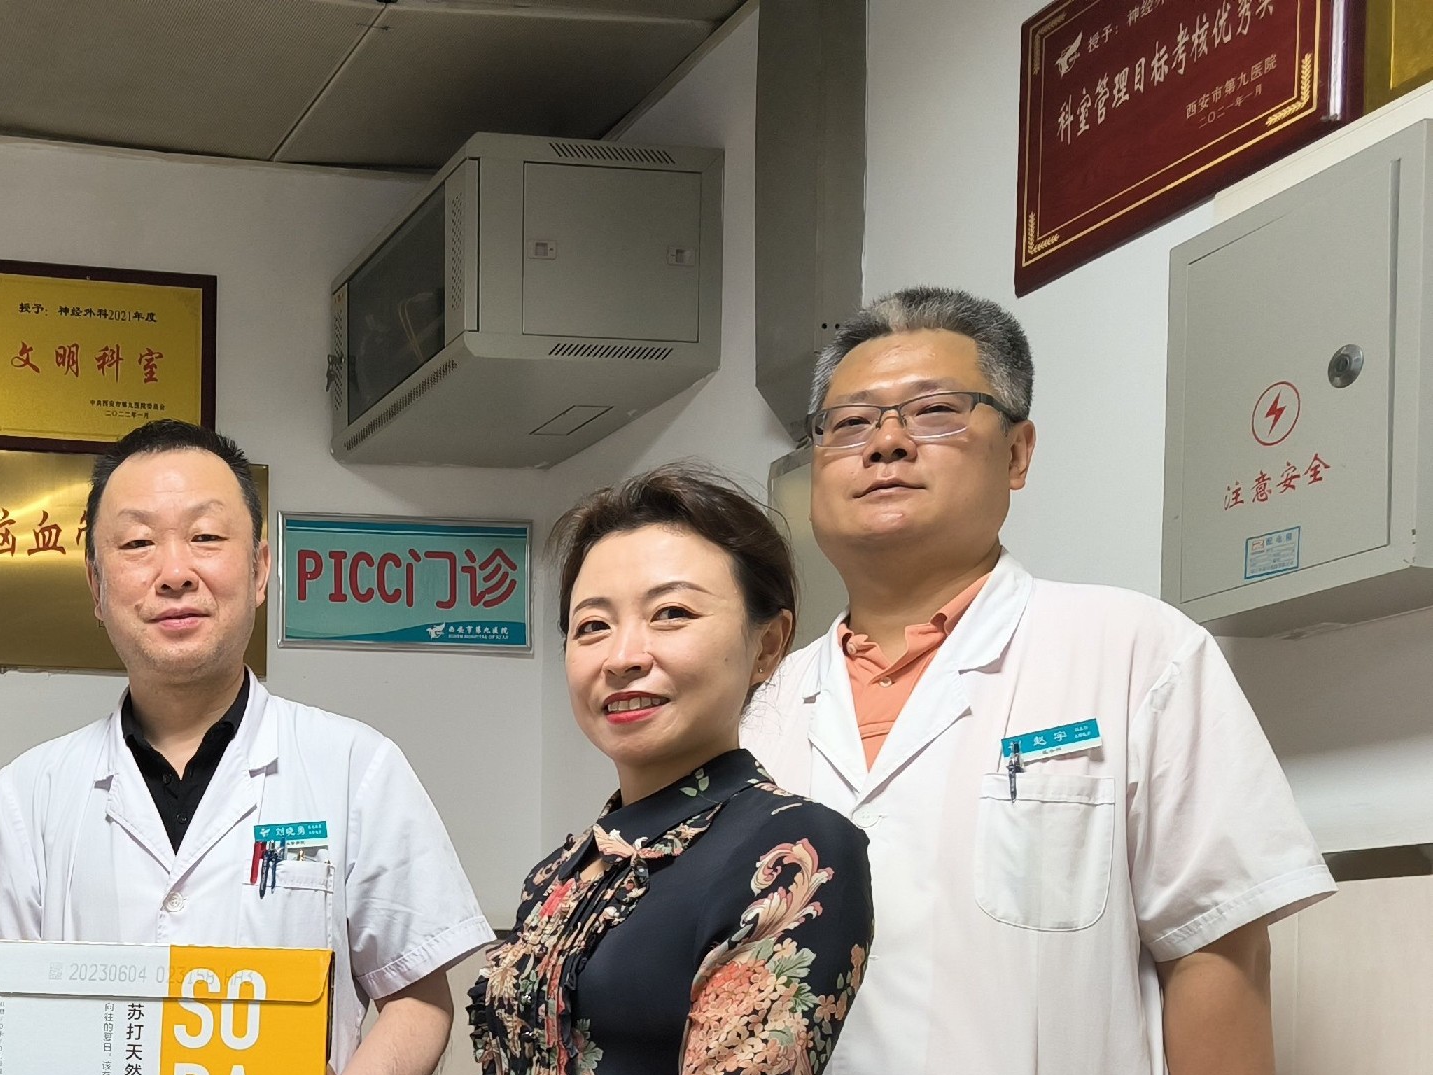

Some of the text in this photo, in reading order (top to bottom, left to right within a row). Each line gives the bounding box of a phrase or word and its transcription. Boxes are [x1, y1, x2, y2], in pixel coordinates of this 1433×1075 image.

[1186, 54, 1277, 119] 西安市第九医院
[58, 306, 157, 322] 神经外科2021年度
[11, 341, 164, 384] 文明科室
[1224, 453, 1331, 510] 注意安全
[297, 549, 517, 609] PICC门诊
[68, 963, 147, 983] 20230604
[173, 968, 266, 1050] SO
